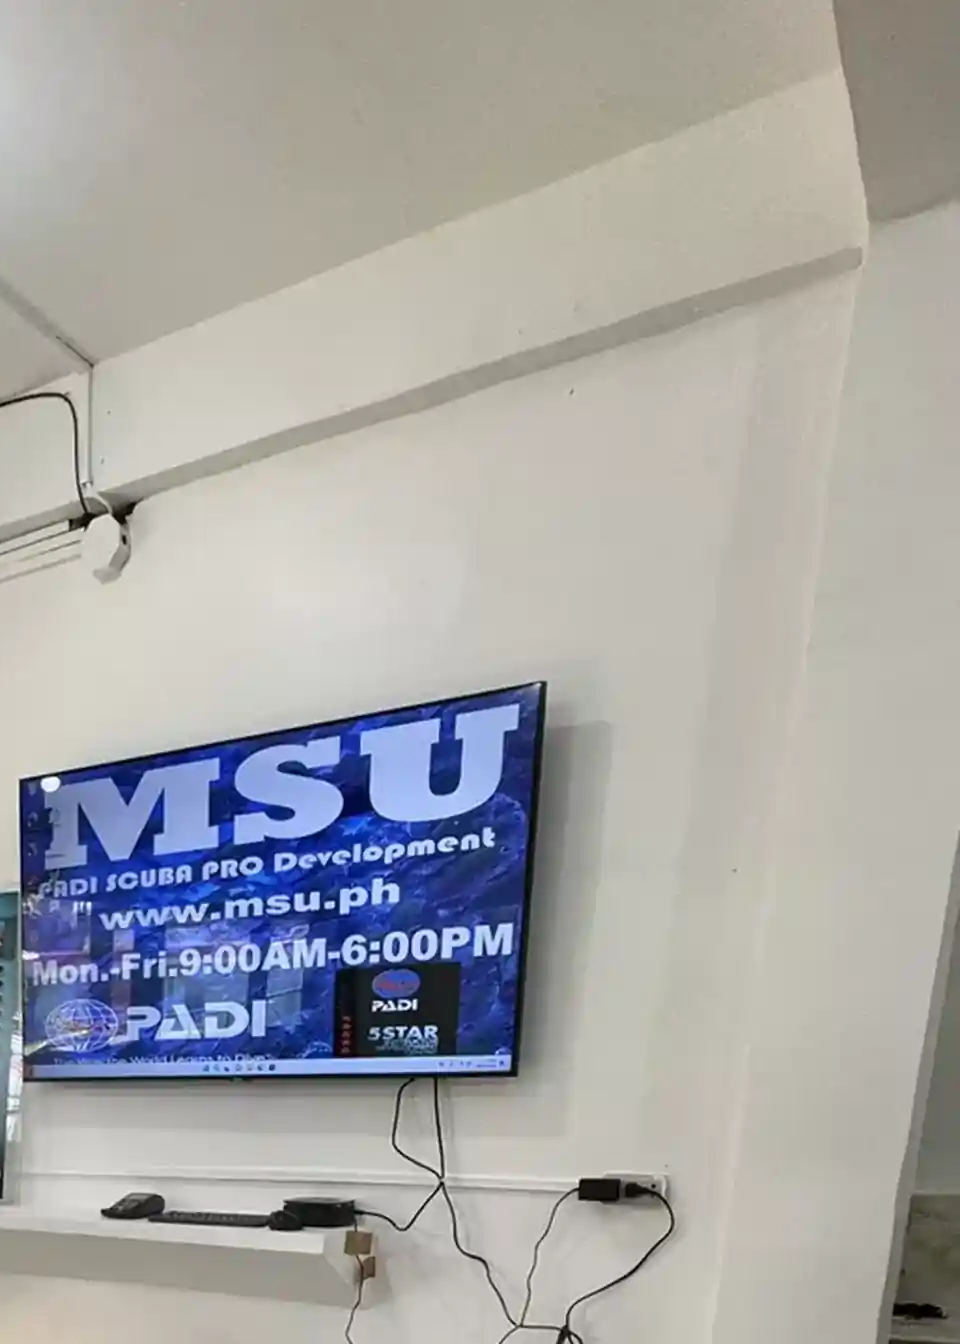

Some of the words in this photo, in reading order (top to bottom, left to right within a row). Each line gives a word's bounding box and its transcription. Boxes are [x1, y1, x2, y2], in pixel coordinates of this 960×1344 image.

[43, 703, 520, 870] MSU
[39, 877, 98, 899] PADI
[106, 864, 192, 892] SCUBA
[202, 854, 264, 883] PRO
[274, 827, 496, 873] Development
[99, 878, 401, 931] www.msu.ph
[120, 999, 272, 1044] PADI
[371, 999, 418, 1012] PADI
